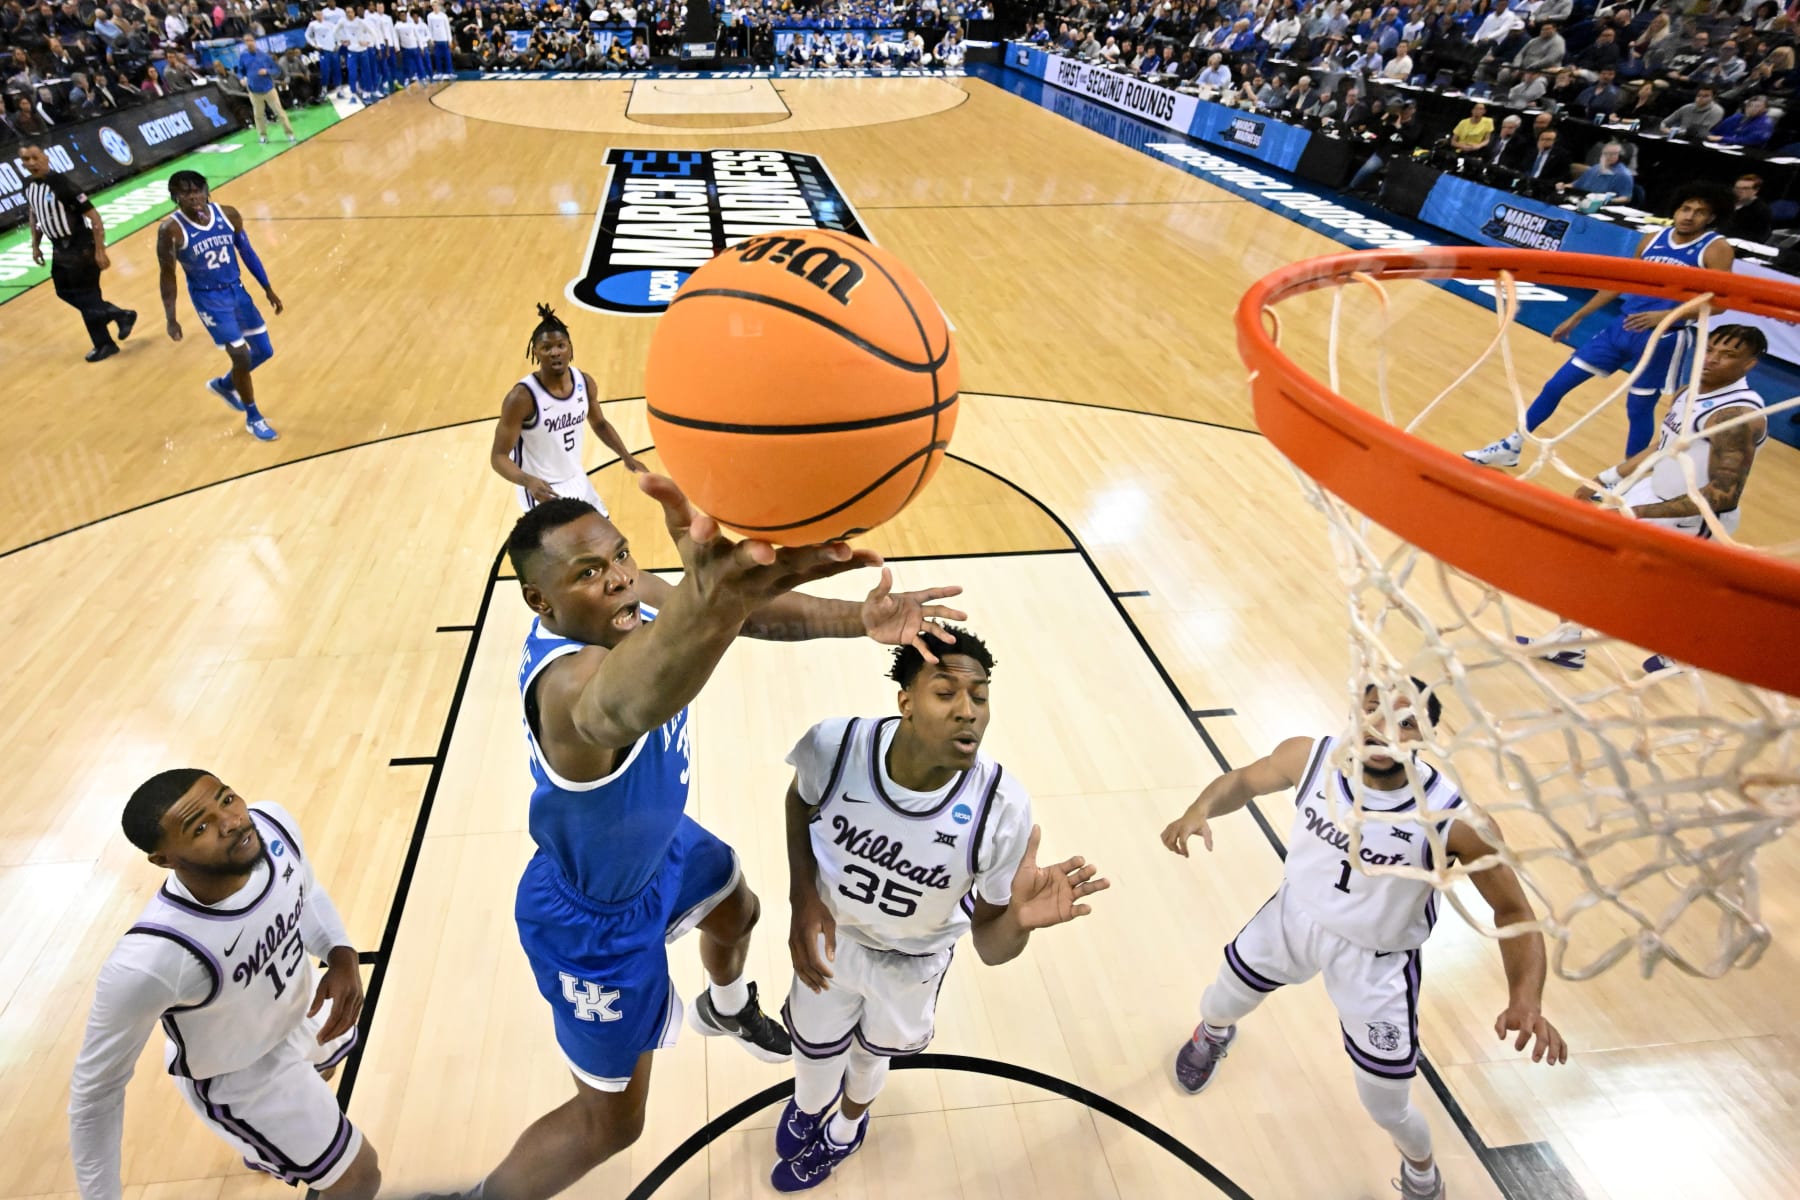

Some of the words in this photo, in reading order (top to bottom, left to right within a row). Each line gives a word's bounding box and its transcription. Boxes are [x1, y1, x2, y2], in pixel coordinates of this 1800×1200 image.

[658, 71, 699, 79] TO
[710, 71, 770, 79] THE
[1058, 61, 1081, 88] FIRST
[1086, 69, 1124, 103] SECOND
[1123, 83, 1176, 121] ROUNDS
[138, 110, 194, 146] KENTUCKY
[608, 177, 715, 267] MARCH
[1504, 208, 1548, 232] MARCH
[1504, 224, 1561, 251] MADNESS
[192, 234, 234, 256] KENTUCKY
[204, 246, 231, 270] 24
[648, 270, 679, 302] NCAA
[563, 430, 575, 452] 5
[832, 815, 953, 889] Wildcats
[1304, 806, 1411, 866] Wilcat
[838, 863, 924, 918] 35
[1334, 859, 1352, 894] 1
[265, 927, 304, 1001] 13
[558, 970, 623, 1023] UK
